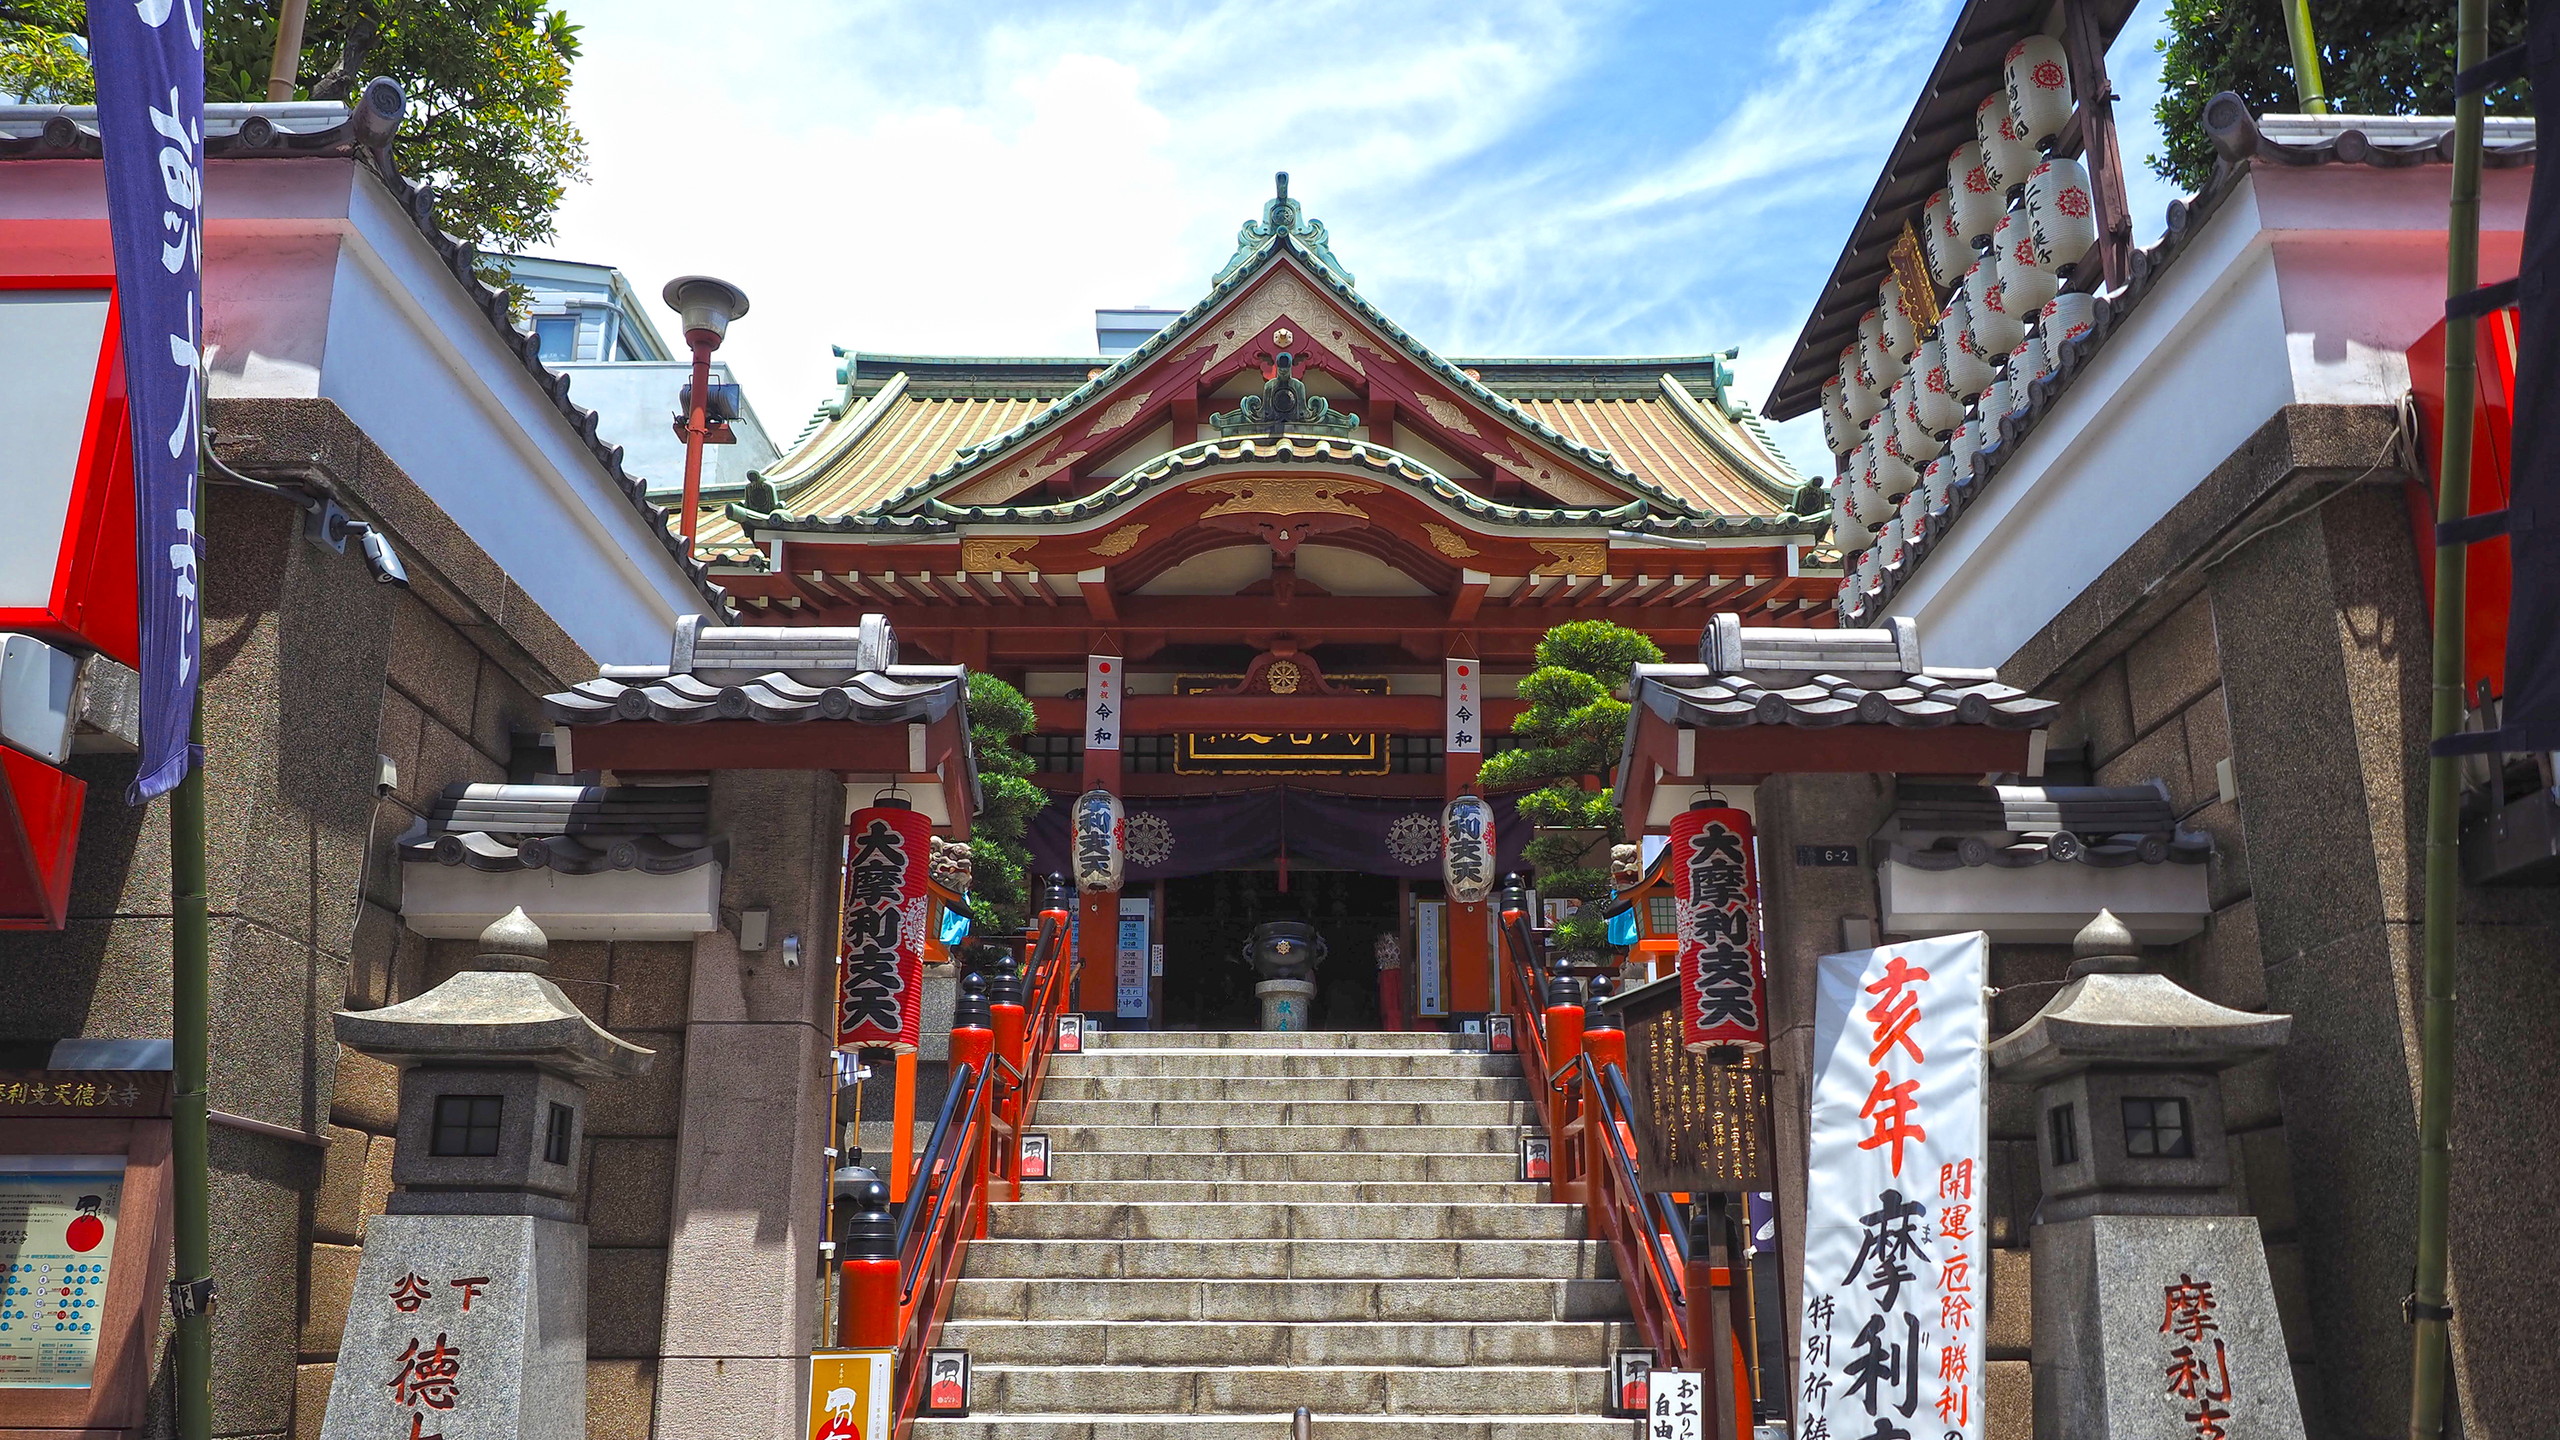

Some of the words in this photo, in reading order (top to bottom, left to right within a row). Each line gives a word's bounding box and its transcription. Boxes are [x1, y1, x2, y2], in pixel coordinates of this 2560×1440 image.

[1094, 702, 1113, 745] 令和
[1455, 706, 1473, 748] 令和
[1078, 793, 1111, 877] 摩利支天
[1448, 802, 1483, 884] 摩利支天
[1825, 850, 1849, 862] 6-2
[842, 821, 906, 1032] 大摩利支天
[1688, 822, 1757, 1029] 大摩利支天
[1857, 956, 1931, 1179] 亥年
[1841, 1187, 1932, 1440] 摩利
[1653, 1392, 1674, 1440] 自由
